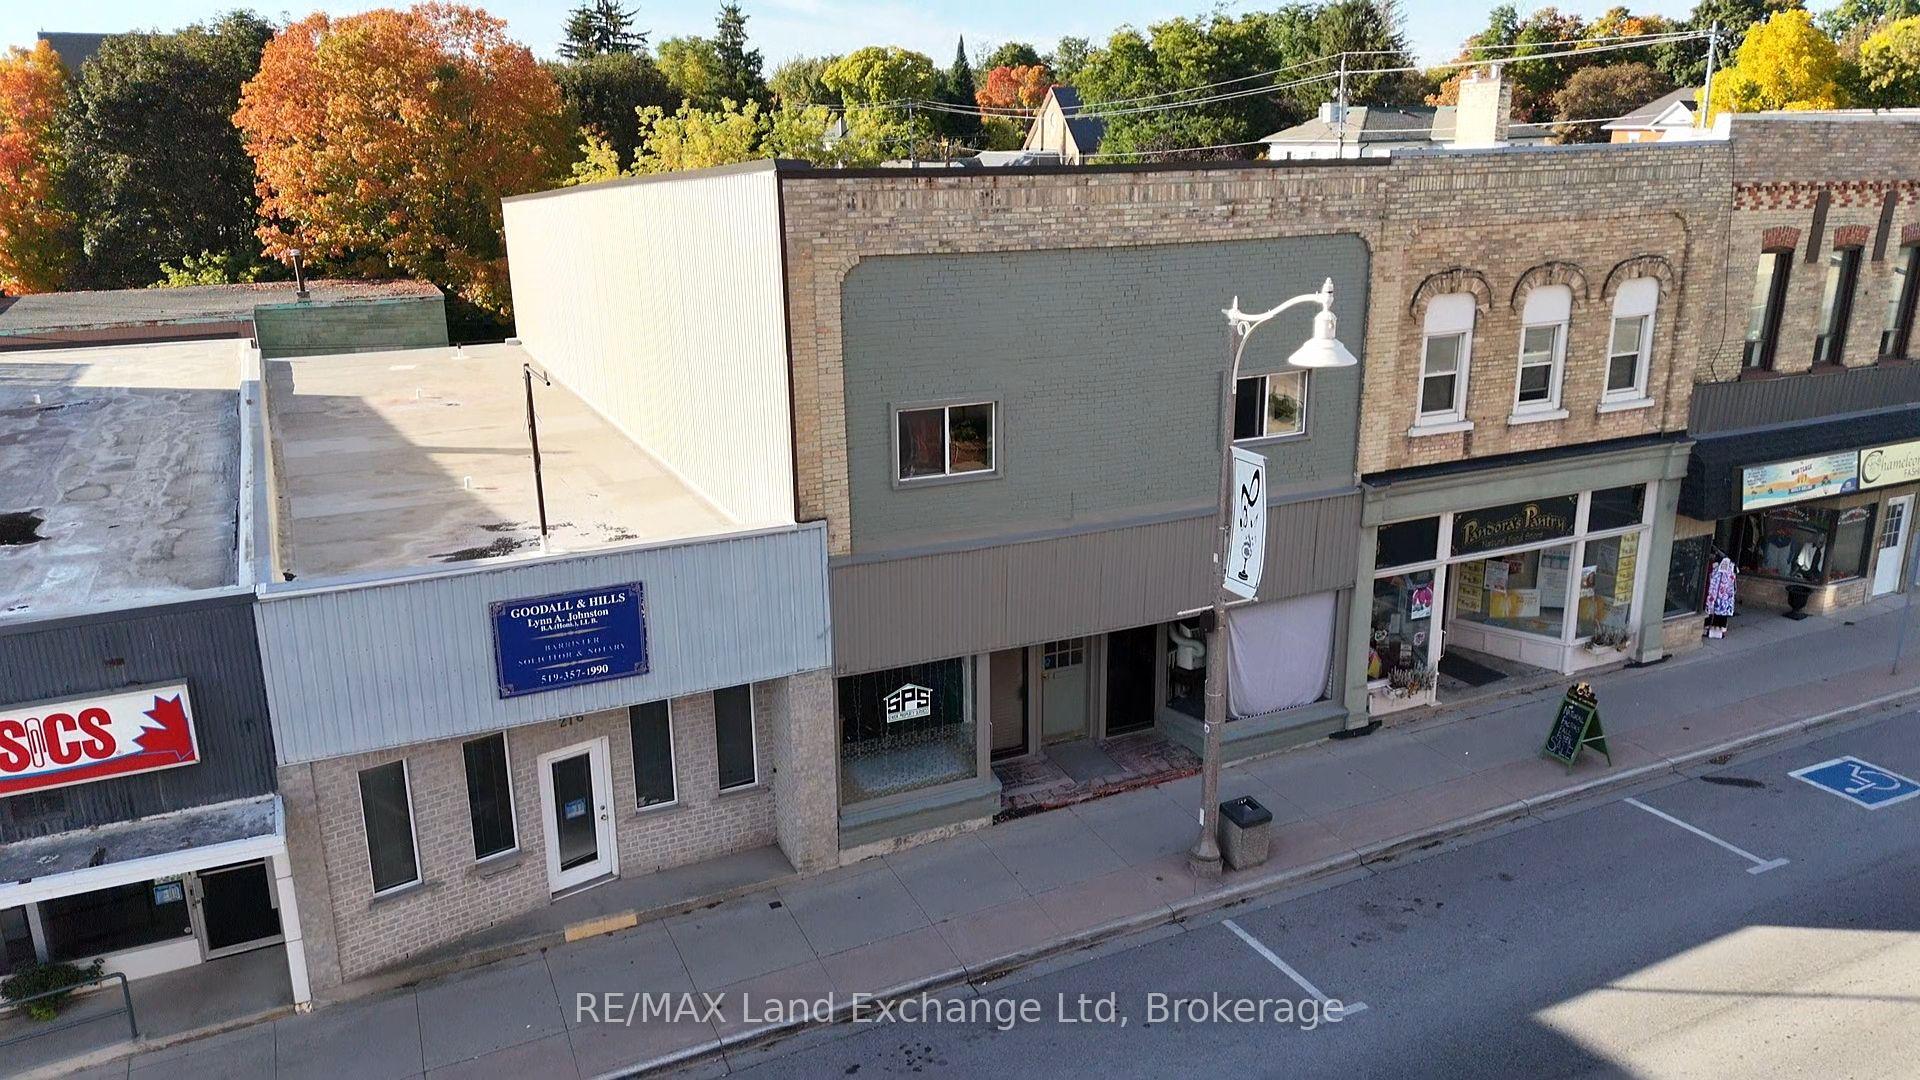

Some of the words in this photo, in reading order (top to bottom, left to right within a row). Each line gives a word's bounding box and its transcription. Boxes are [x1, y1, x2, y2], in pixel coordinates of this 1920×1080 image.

[1861, 450, 1920, 483] Chameleo
[1523, 503, 1565, 531] Pantry
[510, 601, 574, 618] GOODALL
[576, 599, 586, 609] &
[589, 592, 626, 607] HILLS
[527, 616, 553, 629] Lynn
[554, 614, 565, 624] A.
[567, 608, 609, 622] Johnston
[518, 652, 572, 666] SOLICITOR
[576, 650, 583, 658] &
[587, 643, 625, 656] NOTARY
[544, 637, 600, 651] BARRISTER
[541, 664, 609, 683] 519-357-1990
[887, 687, 930, 714] SPS
